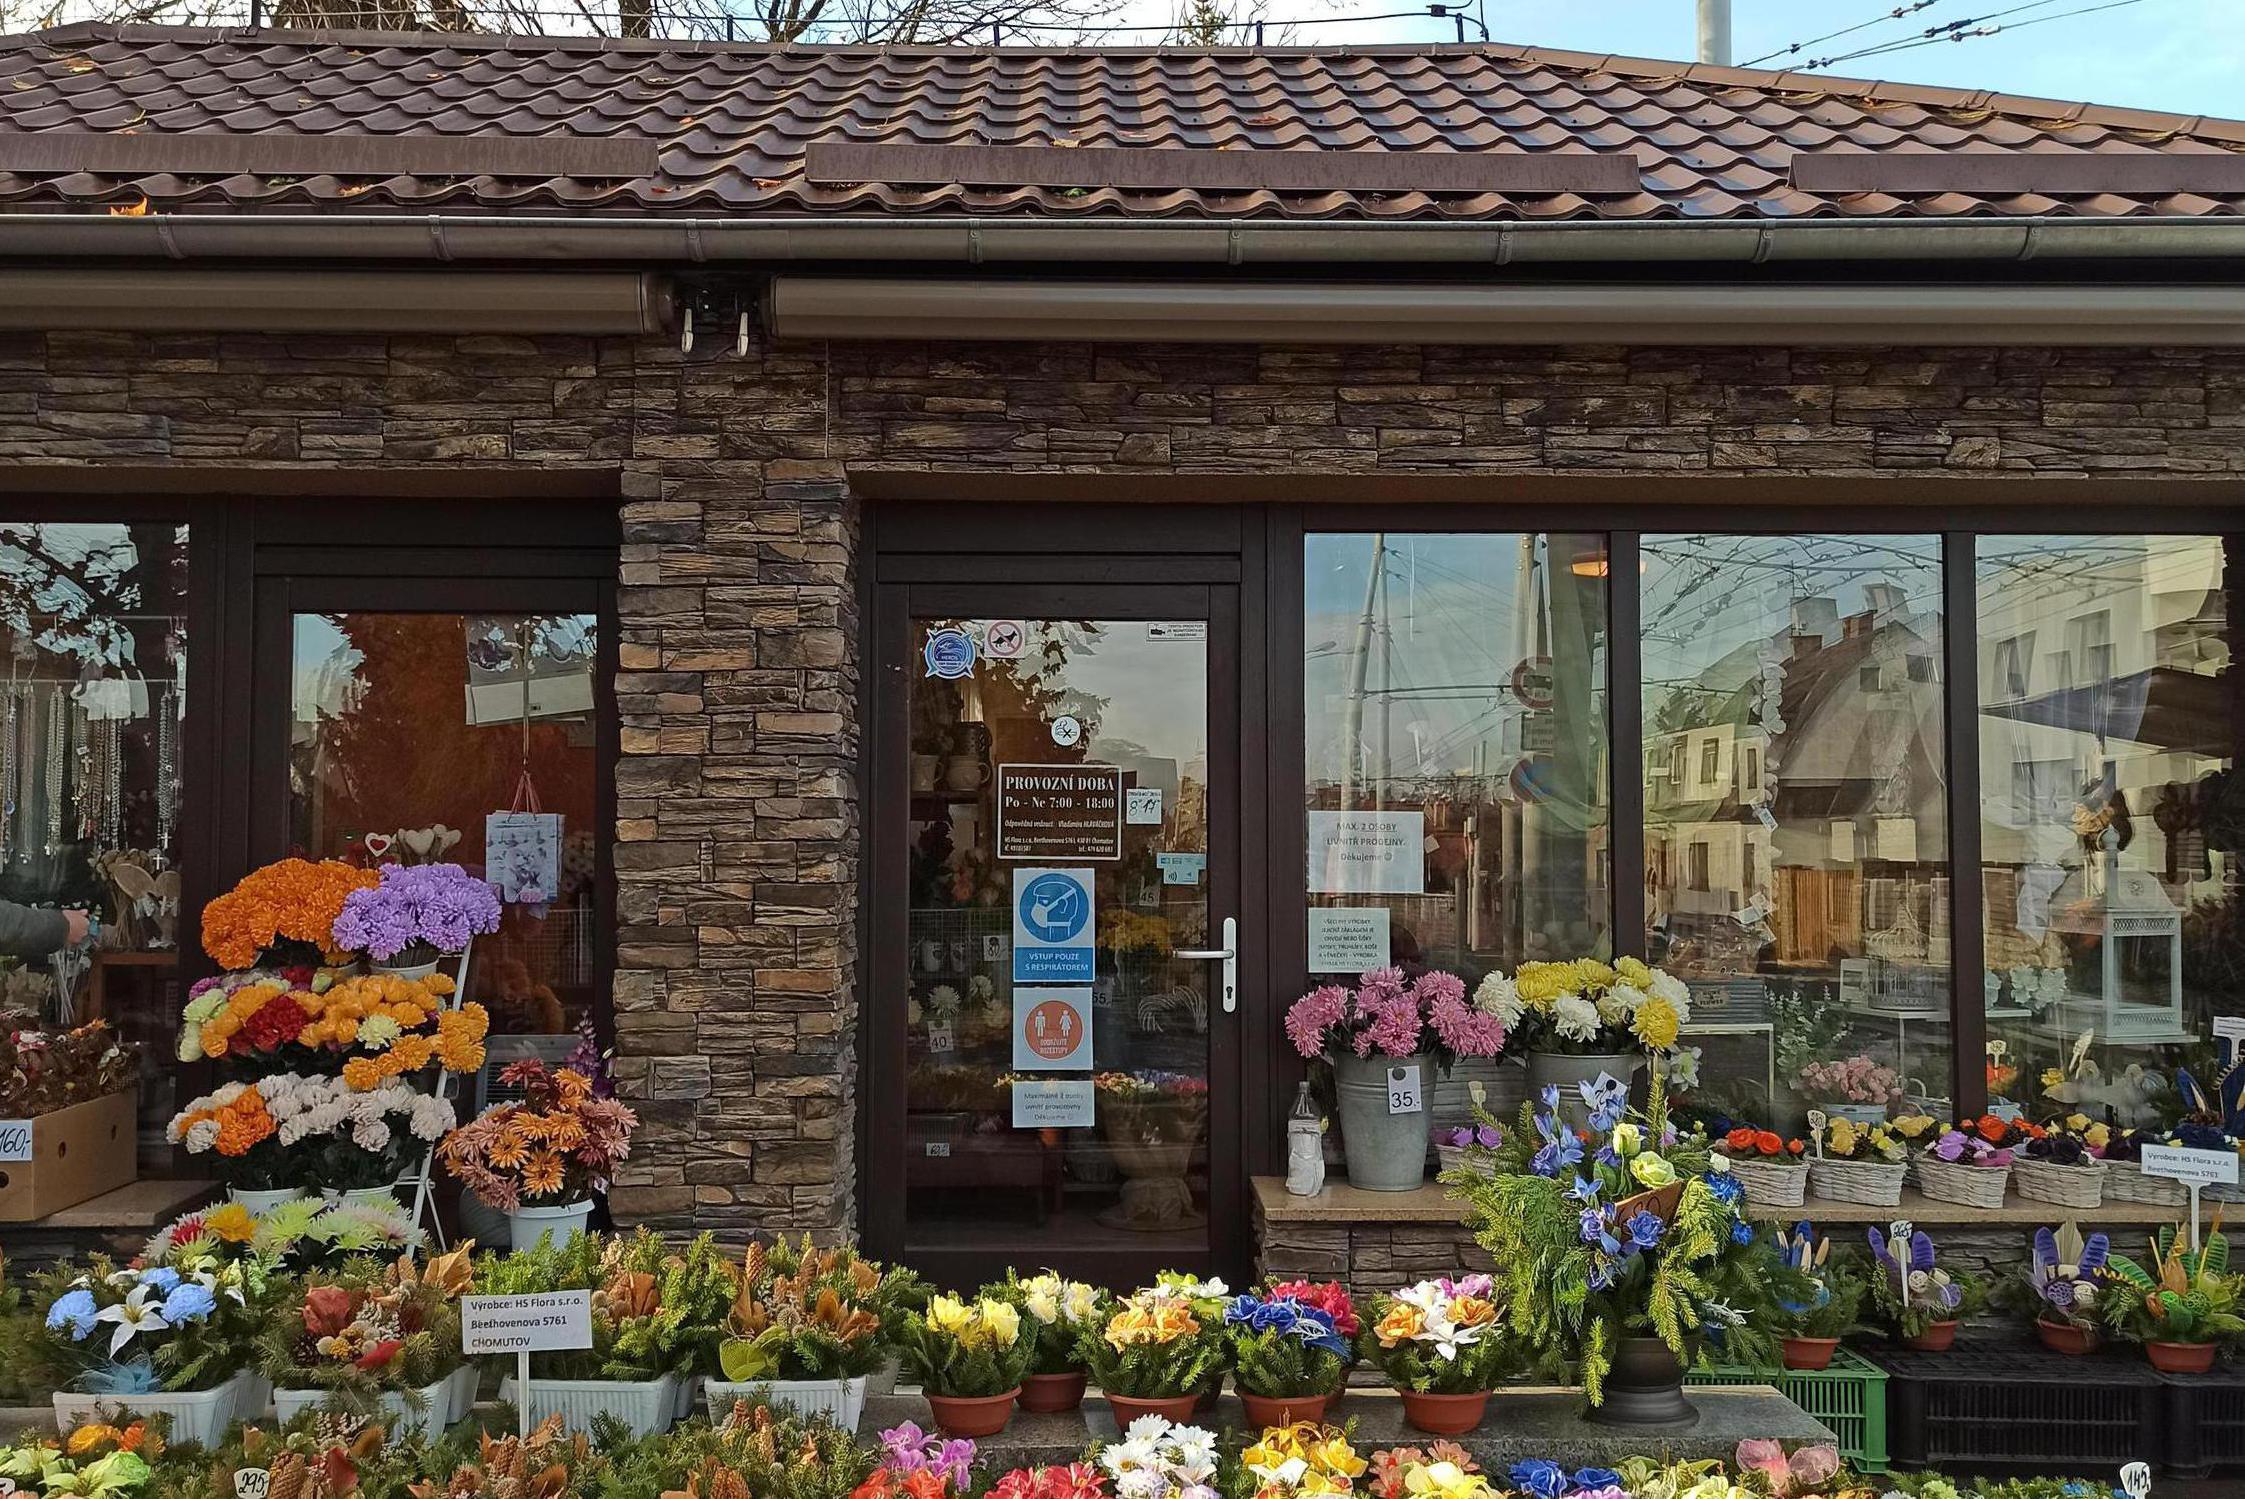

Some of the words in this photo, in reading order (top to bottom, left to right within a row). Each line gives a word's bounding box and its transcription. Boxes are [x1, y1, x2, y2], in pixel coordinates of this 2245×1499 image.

[1005, 774, 1074, 791] PROVOZNÍ
[1078, 777, 1114, 791] DOBA
[1005, 796, 1020, 808] Po
[1032, 796, 1046, 808] Ne
[1049, 797, 1072, 808] 7:00
[1086, 797, 1115, 809] 18:00
[1368, 823, 1397, 831] OSOBY
[1024, 963, 1031, 971] S
[2193, 1156, 2211, 1165] Flora
[515, 1298, 528, 1308] HS
[531, 1298, 555, 1307] Flora
[558, 1297, 583, 1306] s.r.o.
[470, 1318, 540, 1330] Beethovenova
[543, 1315, 567, 1326] 5761
[471, 1336, 531, 1348] CHOMUTOV
